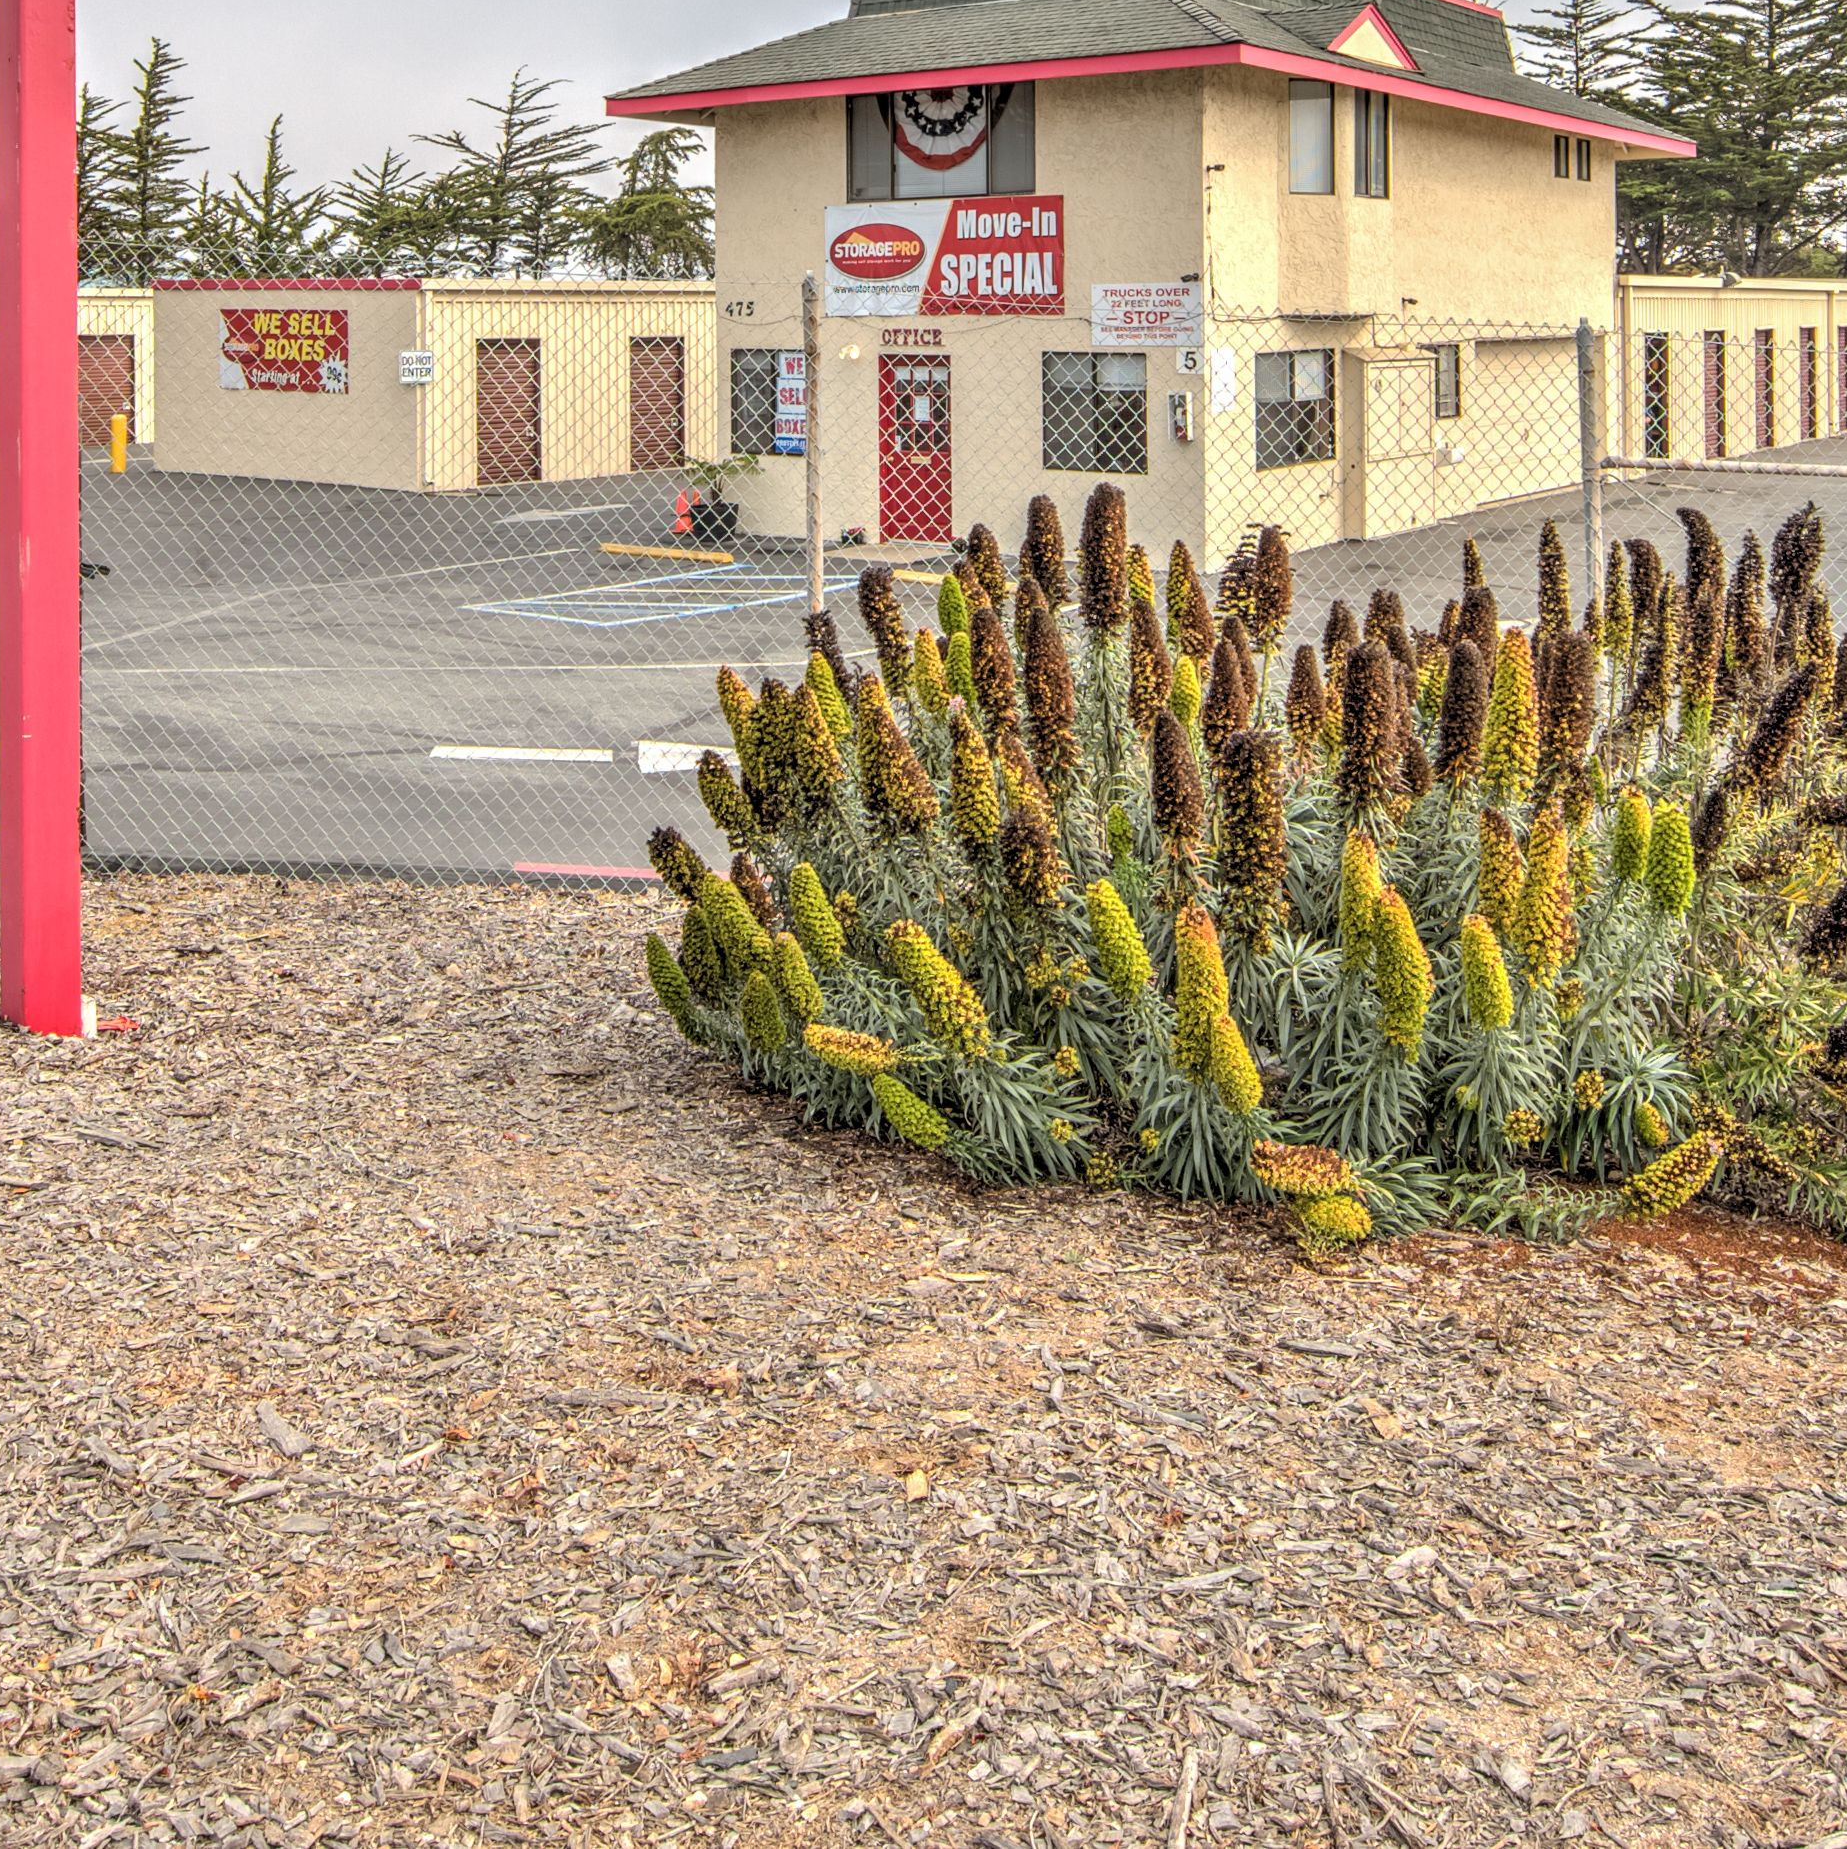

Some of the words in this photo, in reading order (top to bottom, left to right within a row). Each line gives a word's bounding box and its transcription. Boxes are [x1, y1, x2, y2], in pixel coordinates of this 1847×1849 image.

[956, 207, 1057, 240] Move-In
[834, 240, 920, 259] STORAGEPRO
[940, 252, 1058, 297] SPECIAL
[1103, 288, 1152, 298] TRUCKS
[1156, 288, 1190, 297] OVER
[725, 302, 755, 317] 475
[1125, 300, 1150, 308] FEET
[253, 313, 281, 334] WE
[288, 313, 336, 336] SELL
[1123, 311, 1170, 324] STOP
[882, 329, 943, 345] OFFICE
[264, 339, 325, 361] BOXES
[402, 356, 414, 366] DO
[416, 356, 431, 366] NOT
[1184, 351, 1197, 370] 5
[402, 367, 431, 378] ENTER
